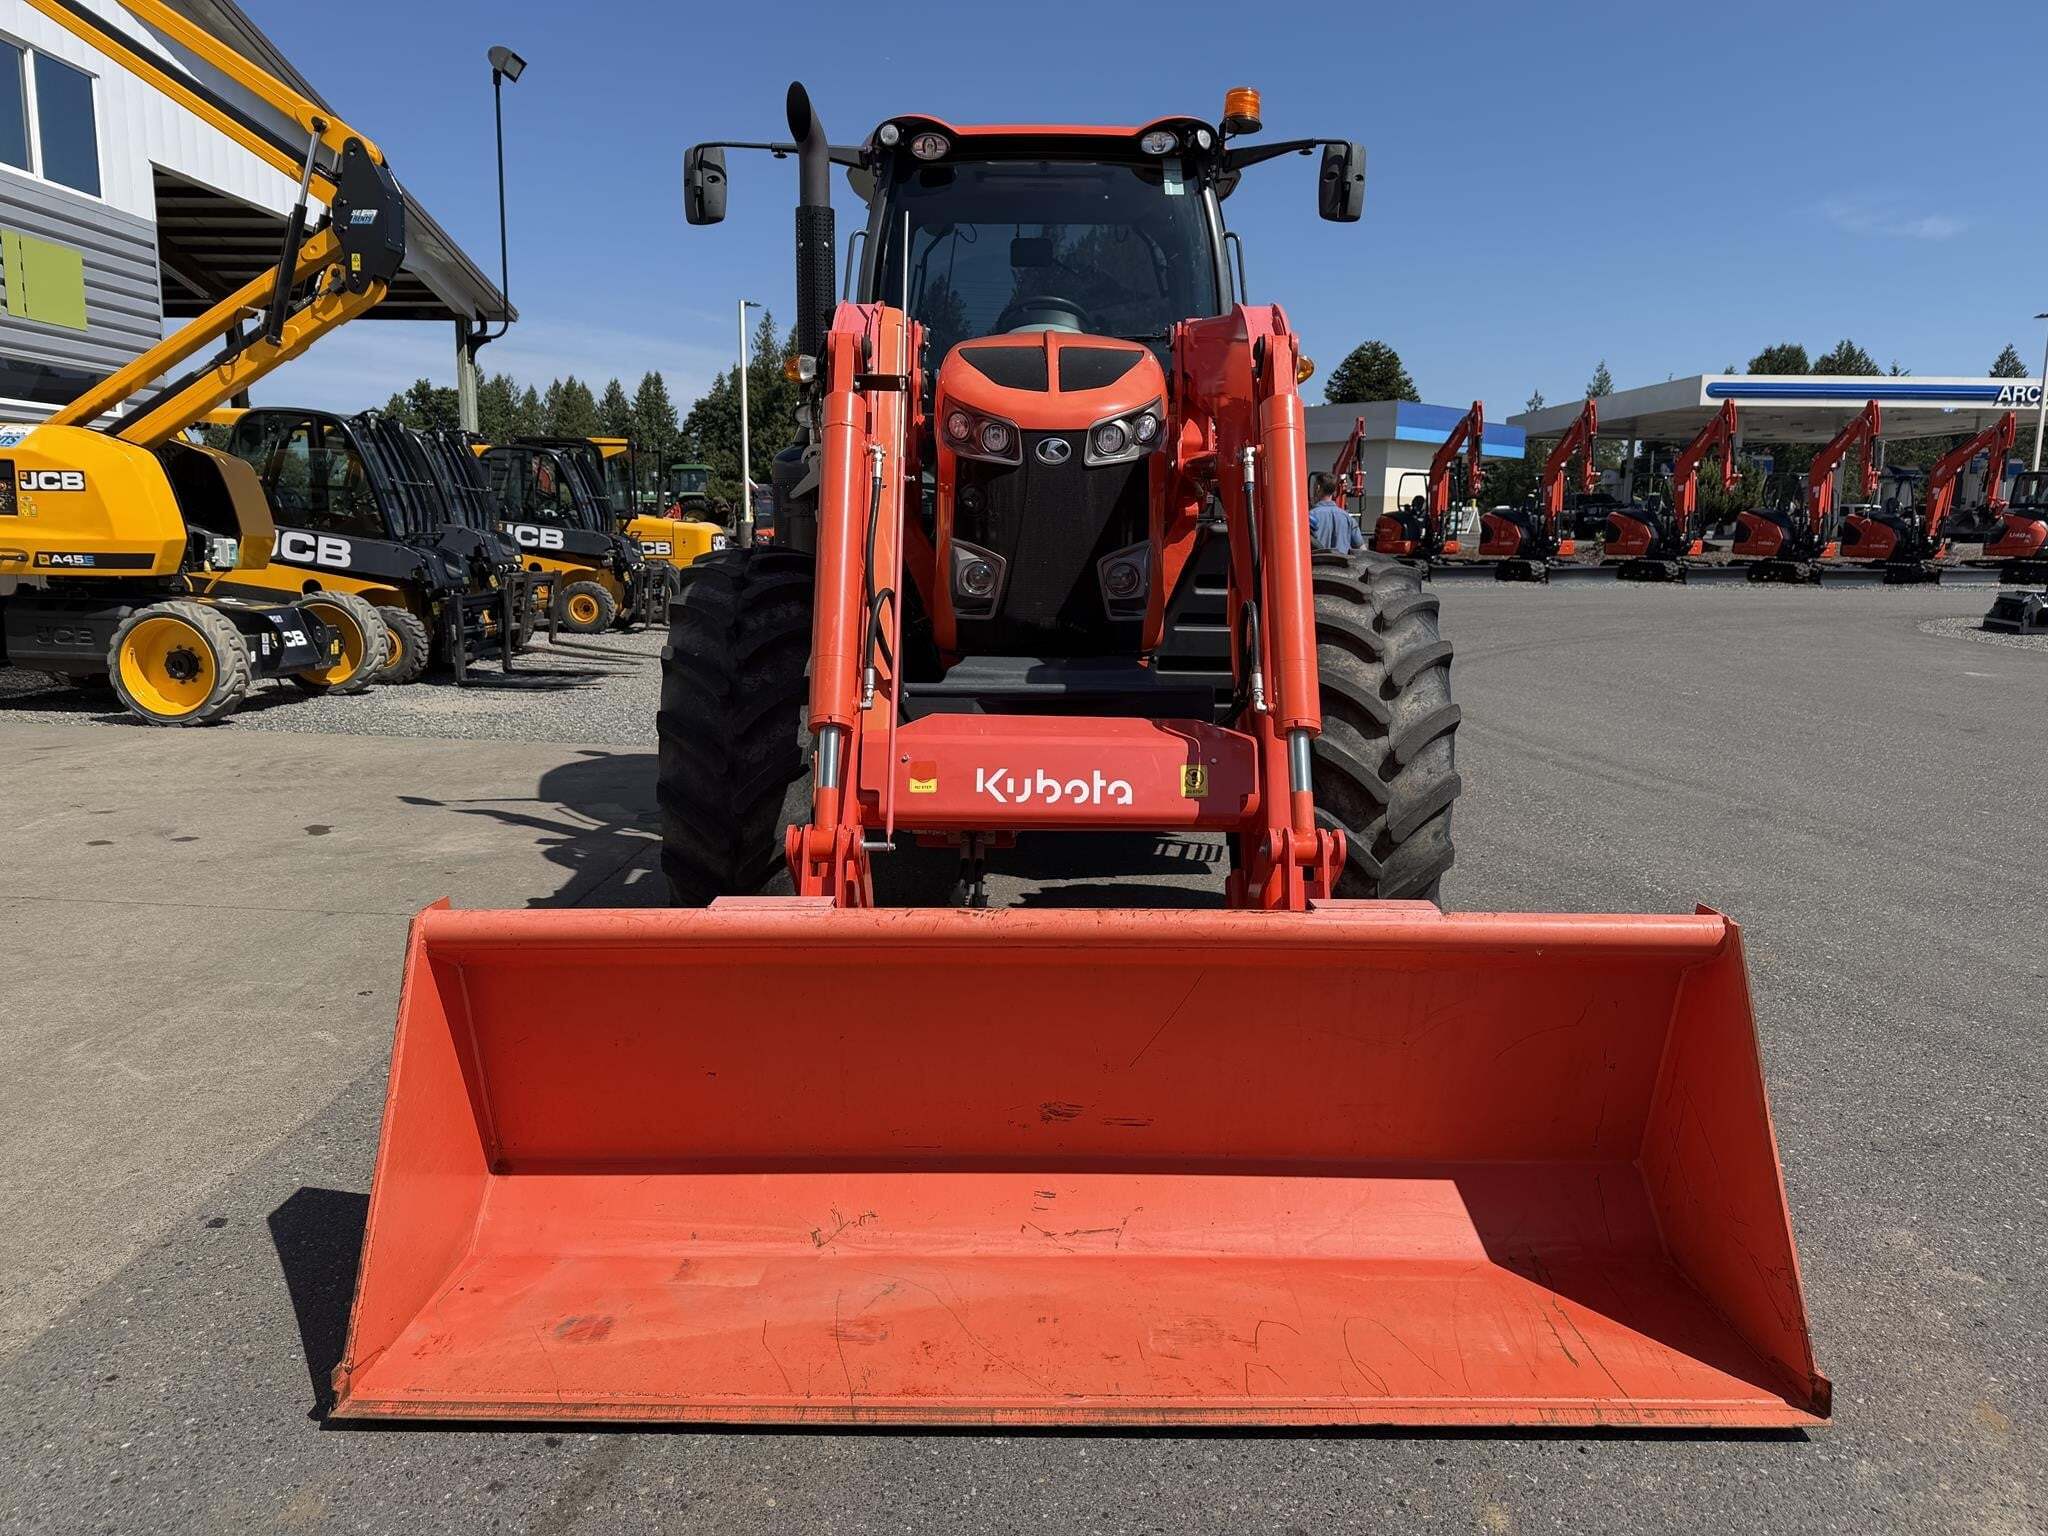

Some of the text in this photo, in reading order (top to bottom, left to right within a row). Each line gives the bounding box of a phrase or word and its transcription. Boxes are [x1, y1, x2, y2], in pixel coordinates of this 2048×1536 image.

[1998, 385, 2041, 402] ARC
[20, 472, 85, 490] JCB
[641, 541, 672, 555] CB
[282, 630, 308, 647] CB
[976, 767, 1133, 805] Kubota
